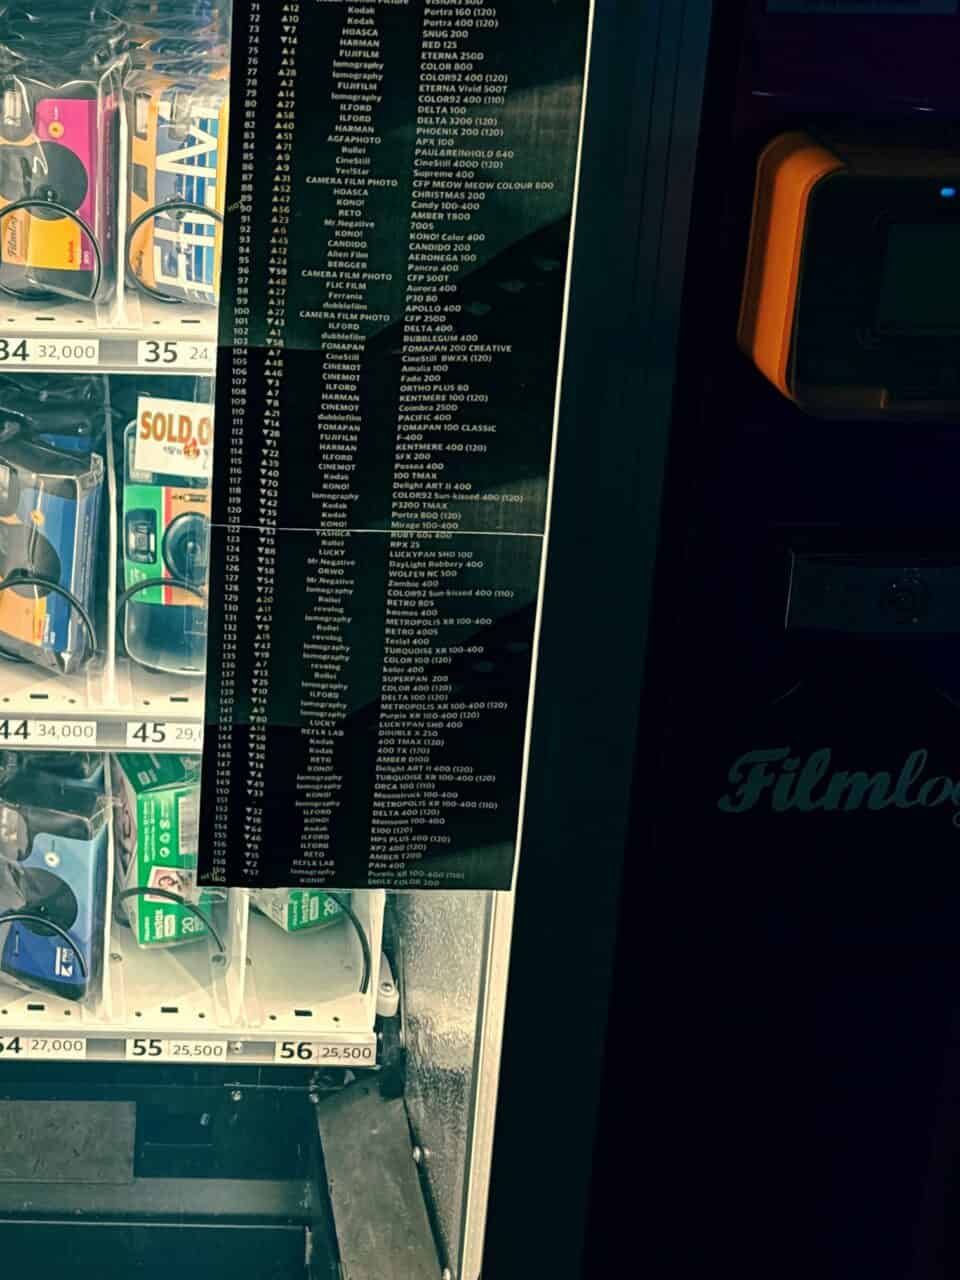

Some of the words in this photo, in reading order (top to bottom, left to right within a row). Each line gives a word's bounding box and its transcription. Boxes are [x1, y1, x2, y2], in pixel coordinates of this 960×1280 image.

[39, 344, 96, 361] 32,000
[144, 342, 179, 364] 35
[139, 411, 194, 445] SOLD
[38, 725, 95, 740] 34,000
[132, 722, 167, 743] 45
[31, 1038, 84, 1053] 27,000
[131, 1038, 163, 1056] 55
[172, 1043, 224, 1058] 25,500
[280, 1041, 313, 1060] 56
[322, 1046, 373, 1060] 25,500
